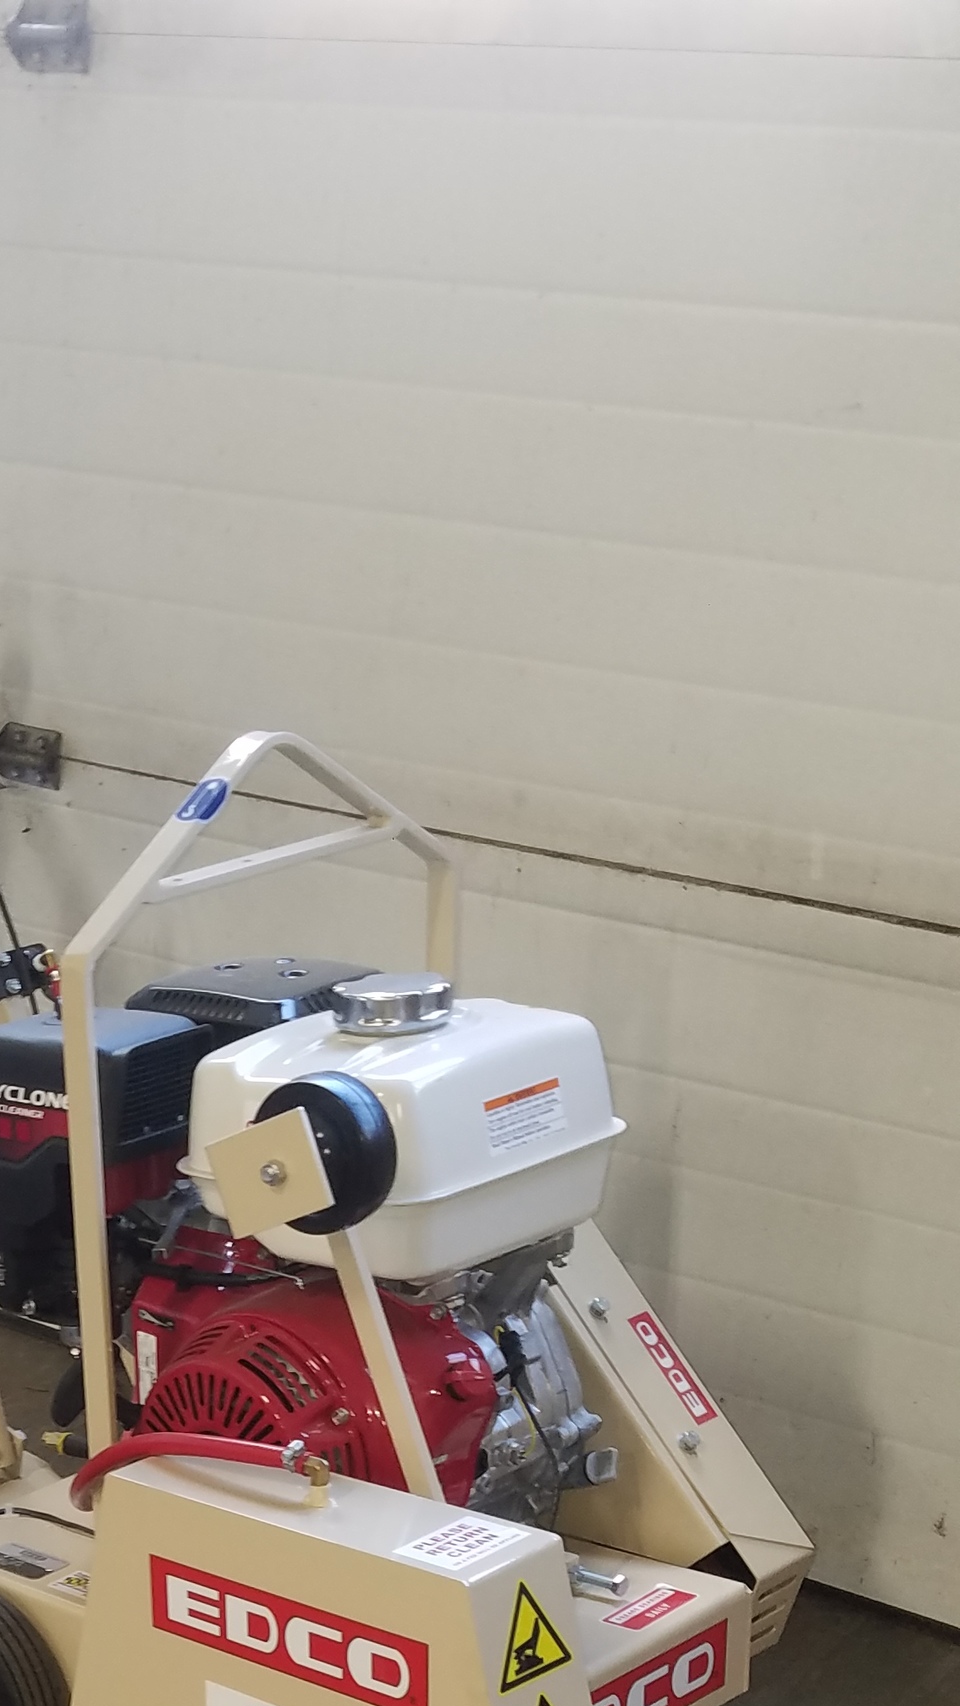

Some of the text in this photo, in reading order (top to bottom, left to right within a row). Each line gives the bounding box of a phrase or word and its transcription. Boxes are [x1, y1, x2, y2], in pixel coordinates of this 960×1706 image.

[635, 1321, 708, 1418] EDCO
[412, 1523, 472, 1551] PLEASE
[425, 1526, 489, 1556] RETURN
[446, 1533, 499, 1558] CLEAN
[165, 1574, 411, 1700] EDCO
